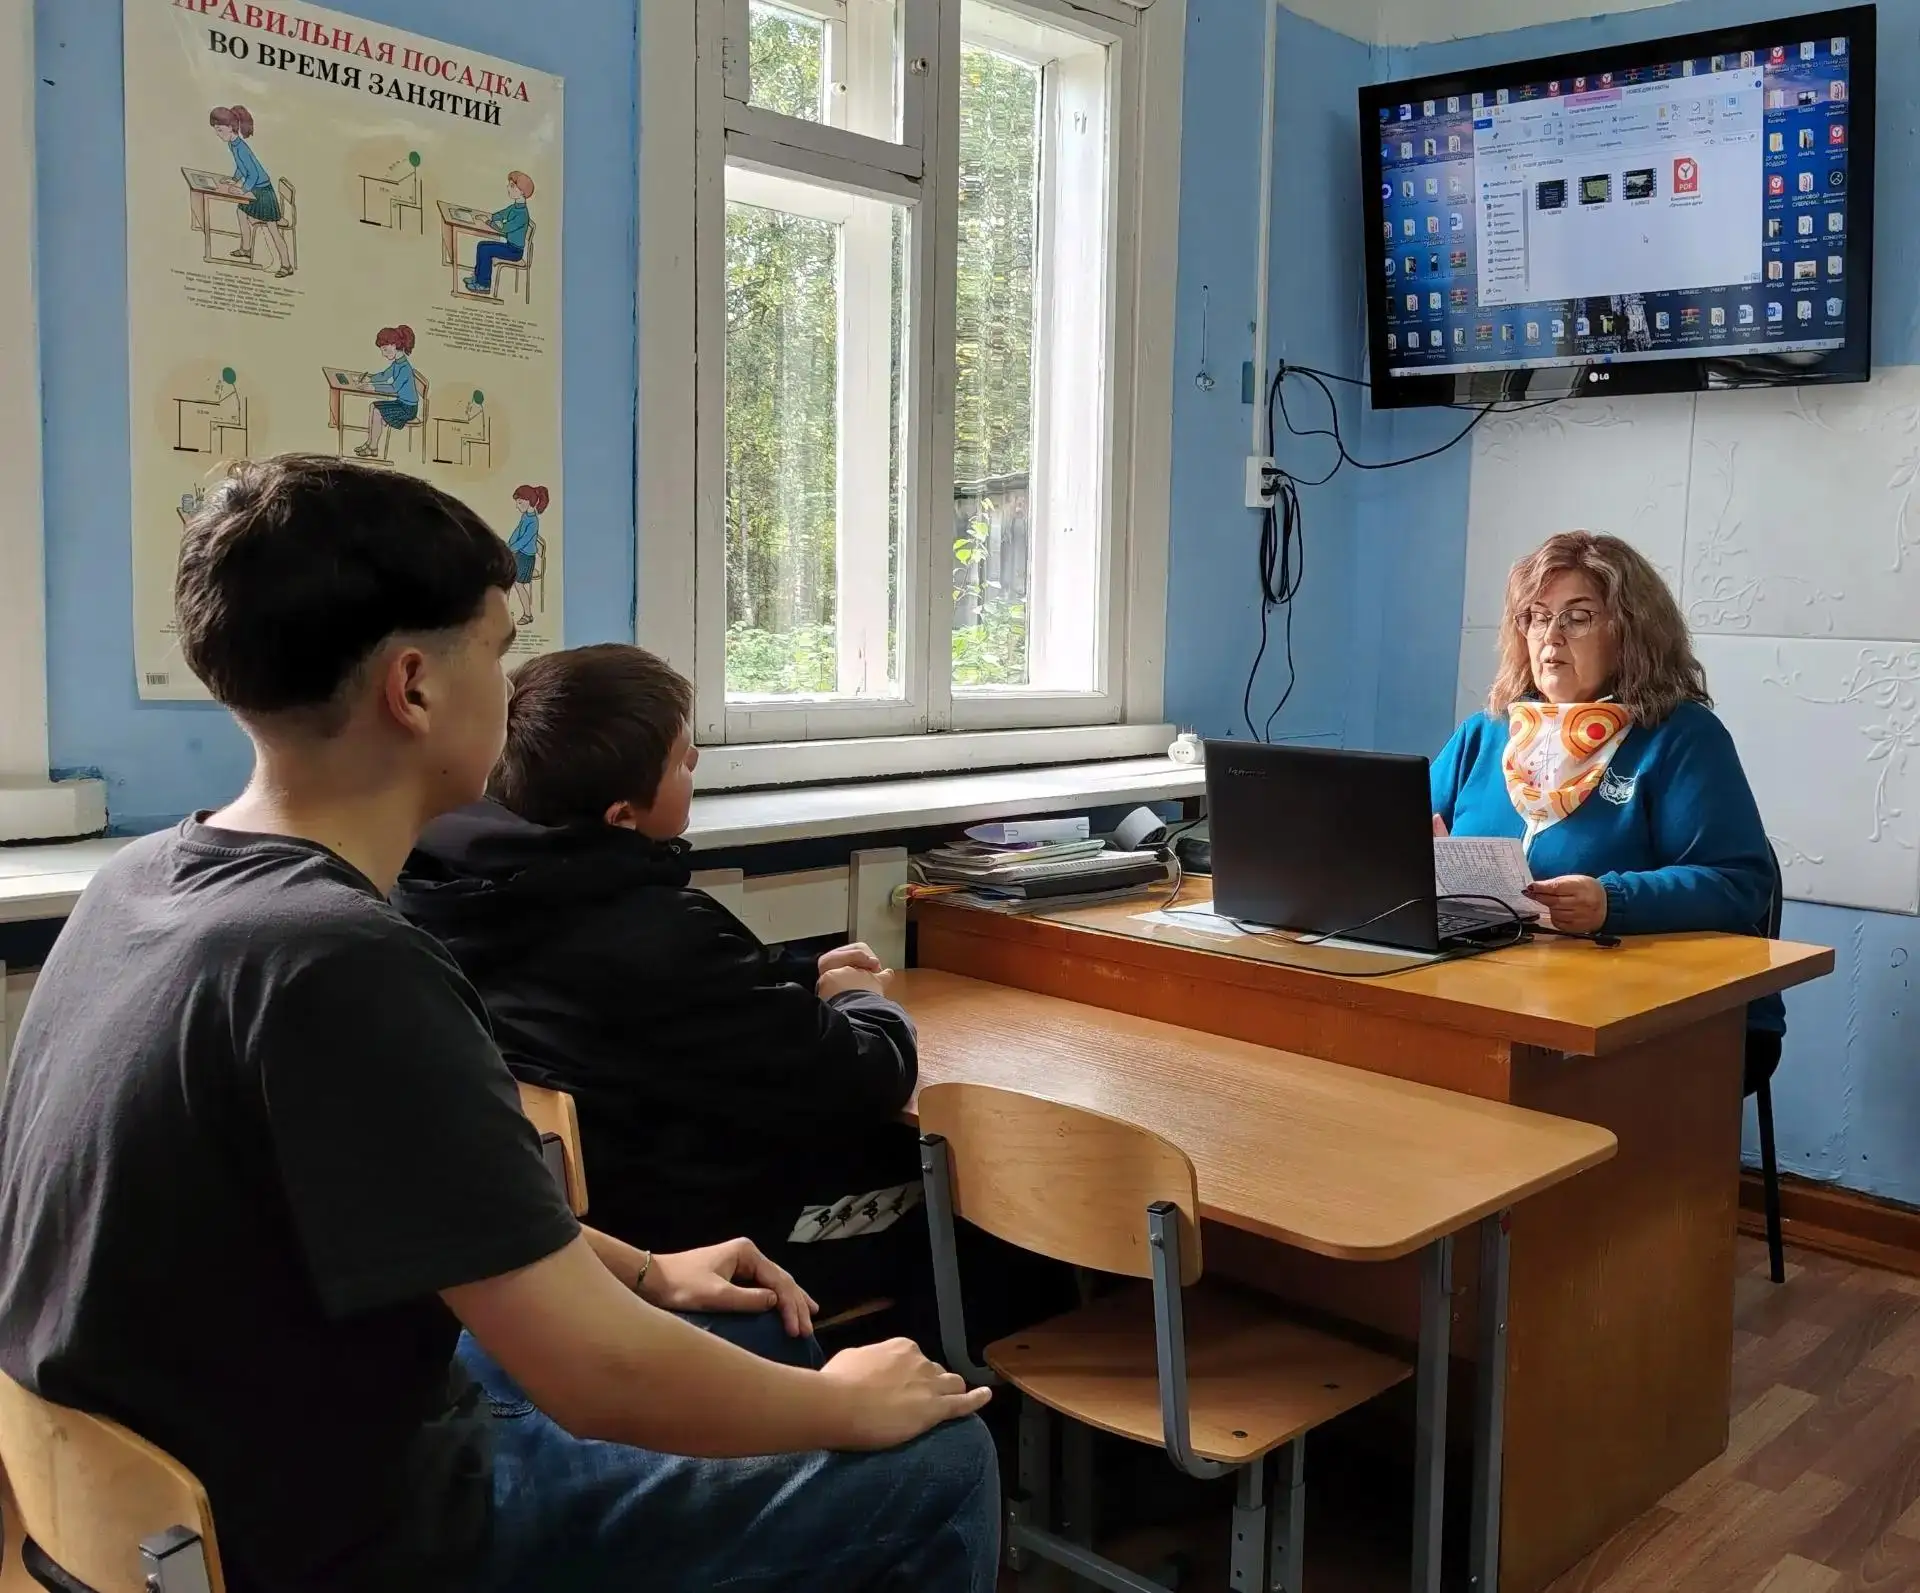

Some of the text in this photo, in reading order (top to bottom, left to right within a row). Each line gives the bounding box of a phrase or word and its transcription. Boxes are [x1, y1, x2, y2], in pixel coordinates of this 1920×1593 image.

[208, 29, 502, 126] ВО ВРЕМЯ ЗАНЯТИЙ
[401, 48, 531, 102] ПОСАДКА
[1679, 182, 1693, 190] PDF
[1599, 373, 1609, 381] LG
